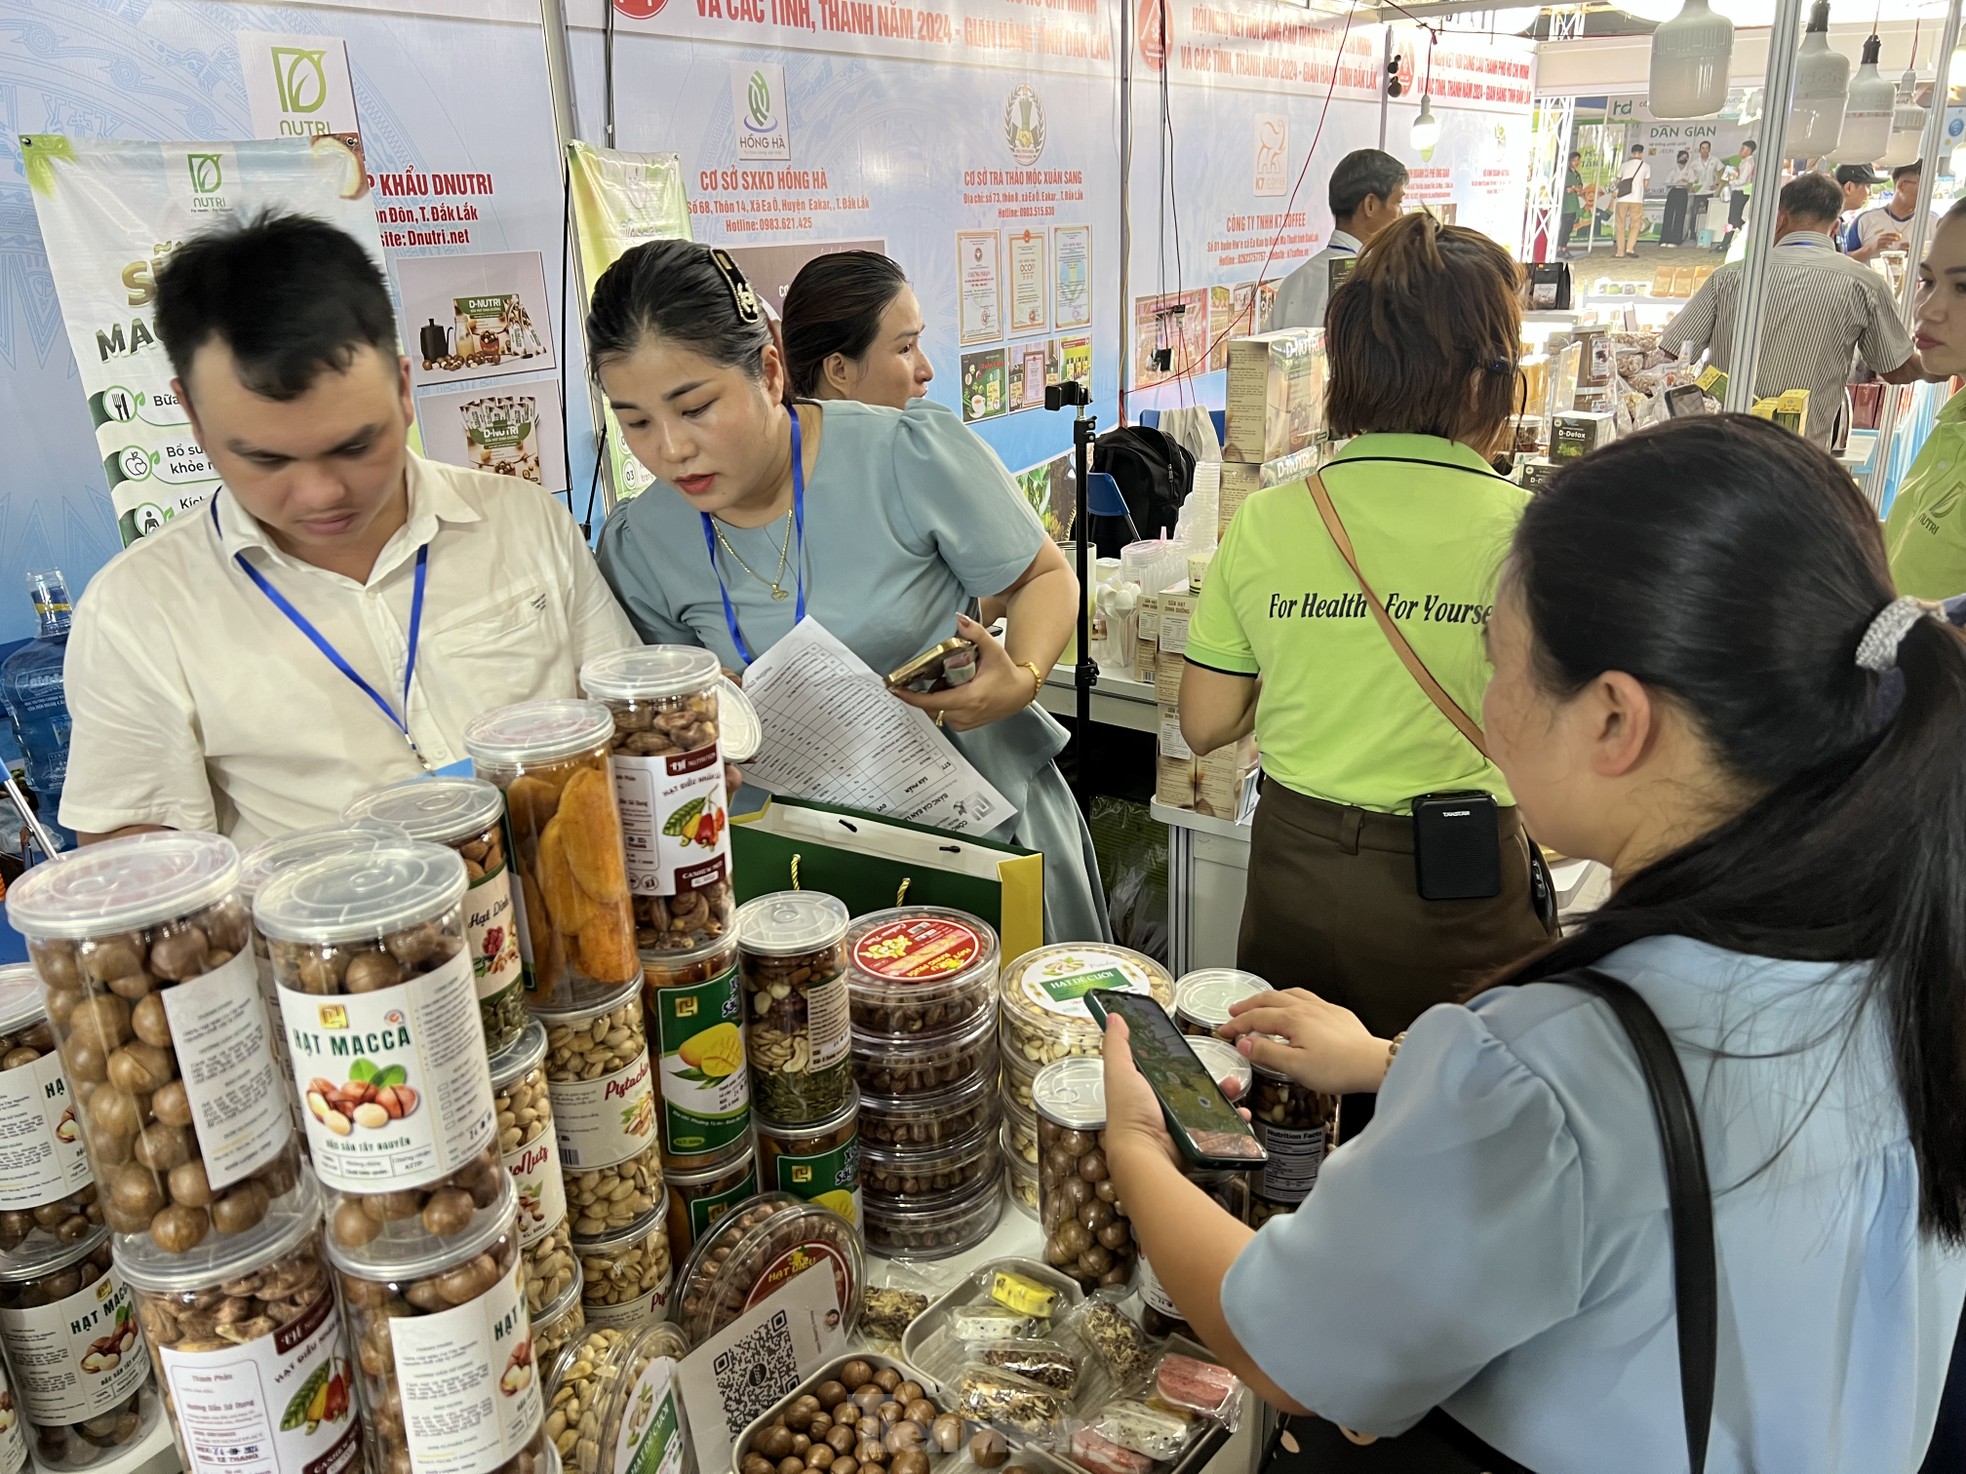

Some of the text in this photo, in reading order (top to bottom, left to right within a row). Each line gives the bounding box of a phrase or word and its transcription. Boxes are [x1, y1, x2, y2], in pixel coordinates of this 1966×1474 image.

[877, 0, 914, 39] NĂM
[917, 11, 952, 43] 2024
[964, 16, 996, 48] GIAN
[1181, 41, 1193, 69] VÀ
[1194, 43, 1211, 72] CÁC
[1280, 58, 1297, 80] 2024
[1650, 124, 1717, 138] DÂN GIAN
[379, 164, 494, 196] KHẨU DNUTRI
[700, 169, 718, 191] CƠ
[721, 164, 739, 191] SỞ
[741, 170, 775, 190] SXKD
[812, 167, 828, 190] HÀ
[964, 169, 975, 186] CƠ
[1005, 166, 1025, 186] THẢO
[1025, 168, 1043, 189] MỘC
[1063, 171, 1083, 185] SANG
[388, 206, 420, 224] Đôn,
[430, 203, 456, 222] Đắk
[456, 202, 479, 221] Lắk
[698, 200, 713, 215] 68,
[713, 200, 735, 213] Thôn
[726, 218, 759, 232] Hotline:
[1226, 213, 1246, 232] CÔNG
[1247, 215, 1255, 231] TY
[1256, 214, 1274, 230] TNHH
[407, 228, 470, 246] Dnutri.net
[1558, 430, 1586, 439] D-Detox
[166, 443, 186, 458] Bổ
[170, 461, 205, 475] khỏe
[626, 470, 635, 481] 03
[1269, 593, 1298, 619] For
[1301, 592, 1368, 618] Health
[1385, 592, 1419, 620] For
[468, 911, 491, 927] Hạt
[292, 1025, 411, 1057] HẠT MACCA
[1267, 1128, 1322, 1140] Nutrition Facts
[70, 1310, 98, 1335] HẠT
[494, 1307, 518, 1342] HẠT
[275, 1362, 295, 1384] HẠT
